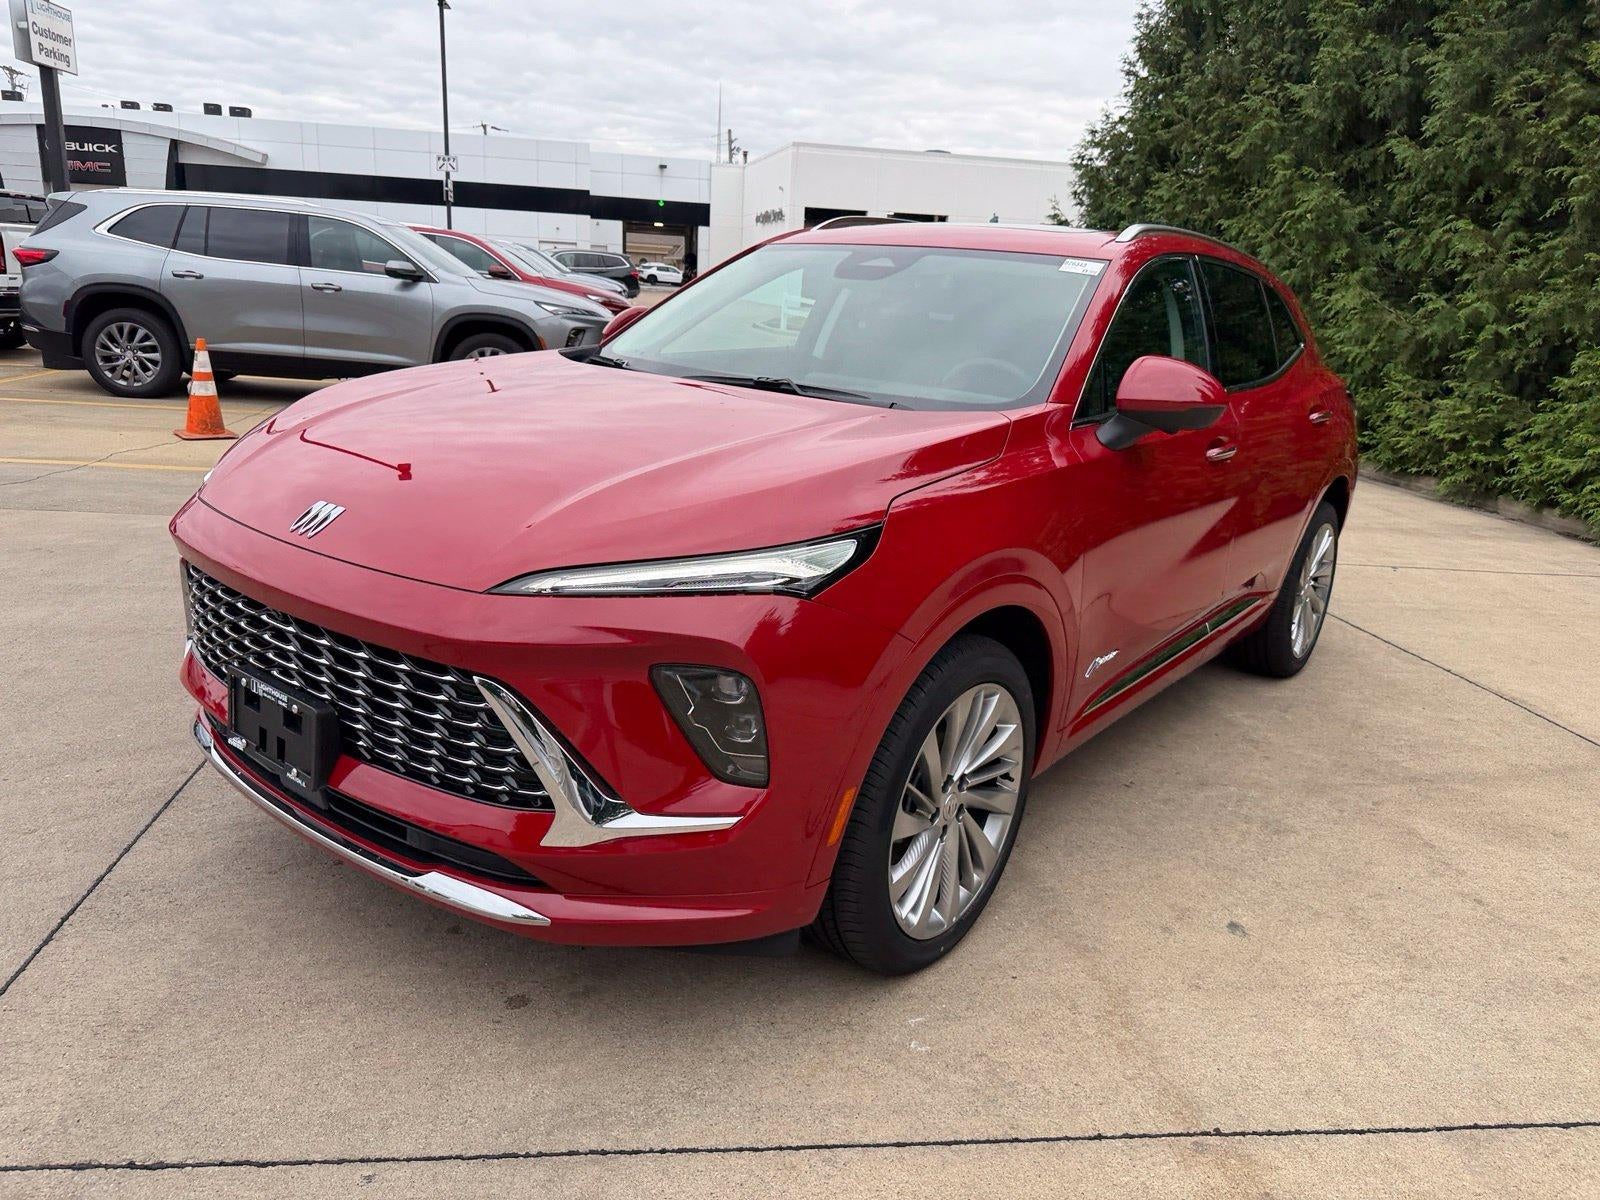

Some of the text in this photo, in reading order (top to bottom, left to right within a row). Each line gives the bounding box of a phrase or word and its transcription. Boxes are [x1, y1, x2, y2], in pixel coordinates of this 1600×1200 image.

[36, 1, 72, 22] LIGHTHOUSE
[31, 20, 72, 47] Customer
[38, 42, 71, 67] Parking
[64, 141, 118, 153] BUICK
[257, 682, 288, 702] LIGHTHOUSE
